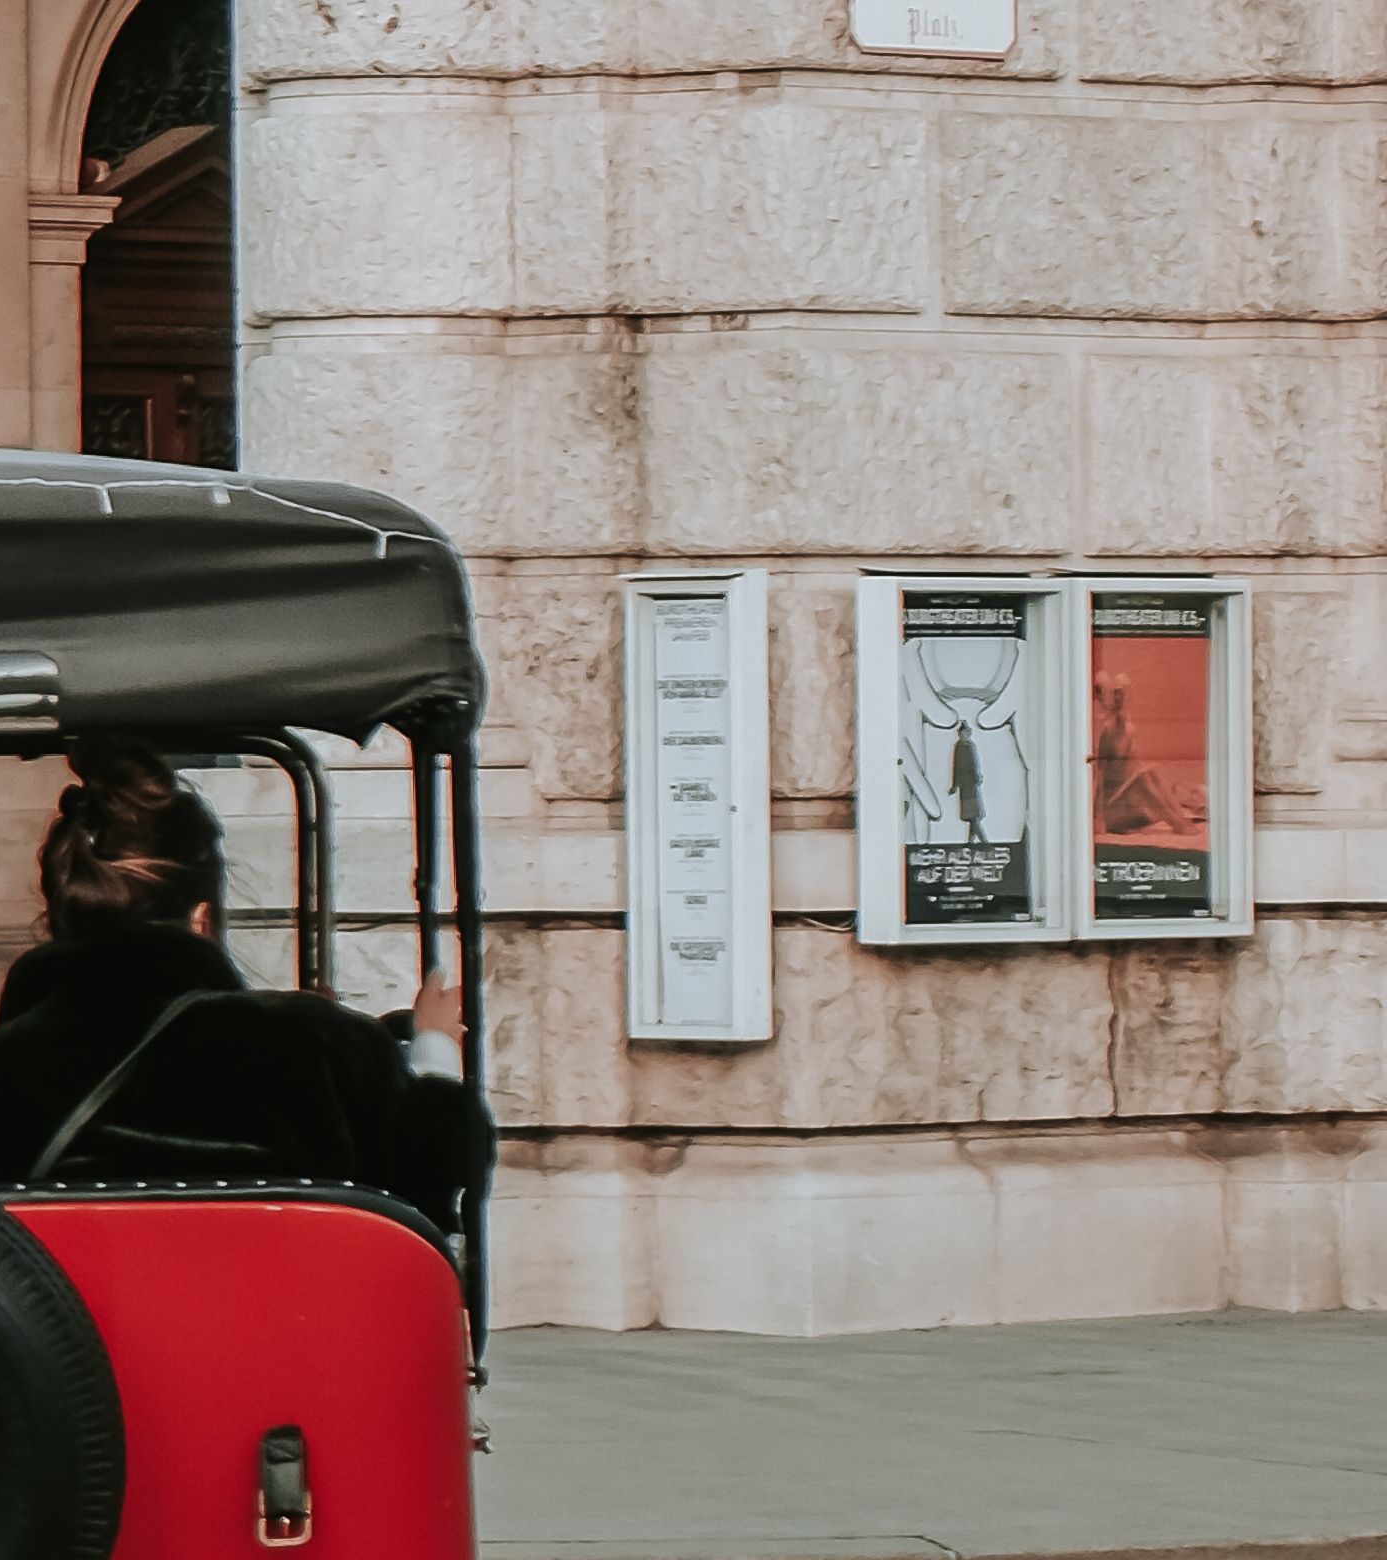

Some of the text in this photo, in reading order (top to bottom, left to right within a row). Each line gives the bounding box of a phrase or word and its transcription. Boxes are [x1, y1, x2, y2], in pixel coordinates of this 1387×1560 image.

[948, 847, 972, 865] ALS
[973, 847, 1011, 864] ALLES
[917, 865, 942, 883] AUF
